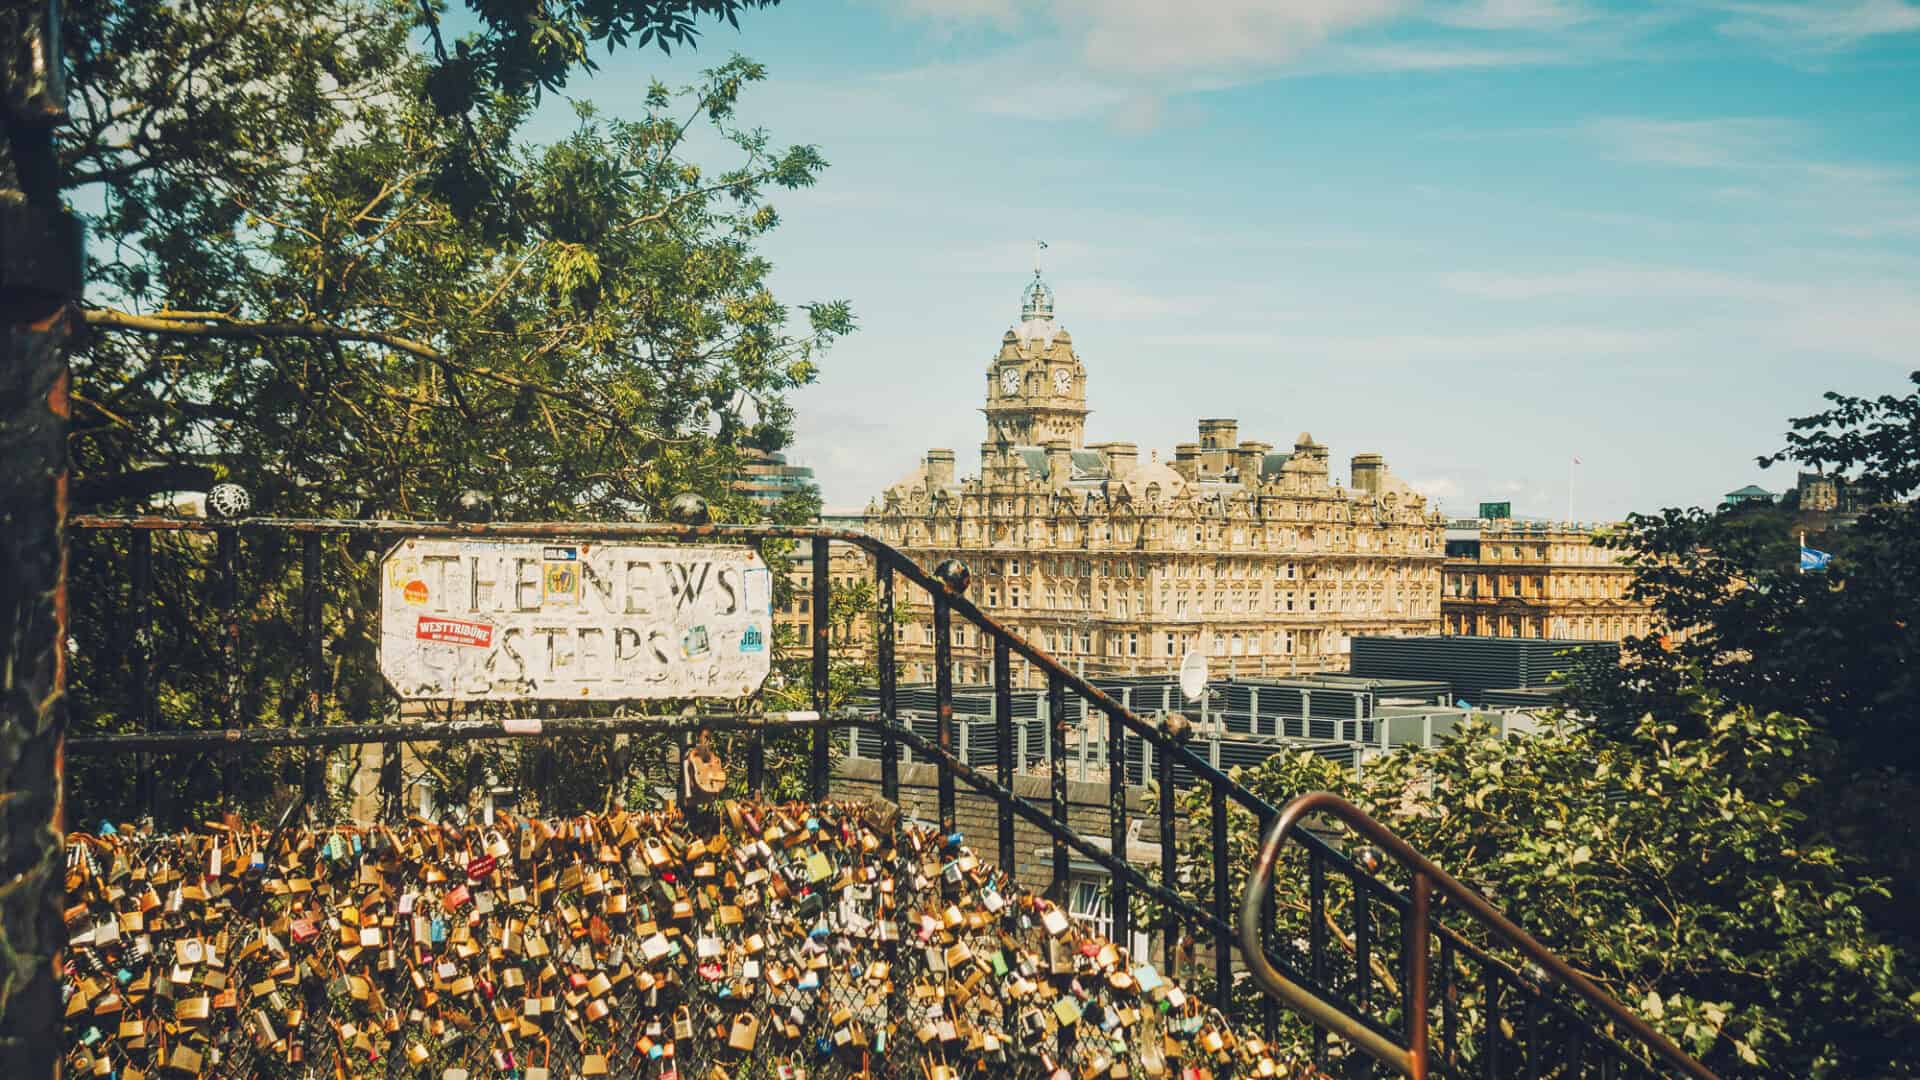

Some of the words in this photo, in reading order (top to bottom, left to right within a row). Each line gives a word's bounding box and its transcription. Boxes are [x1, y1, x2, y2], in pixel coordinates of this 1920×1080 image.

[421, 555, 541, 614] THE
[577, 559, 738, 621] NEWS
[485, 626, 670, 684] STEPS
[741, 631, 763, 645] JBN
